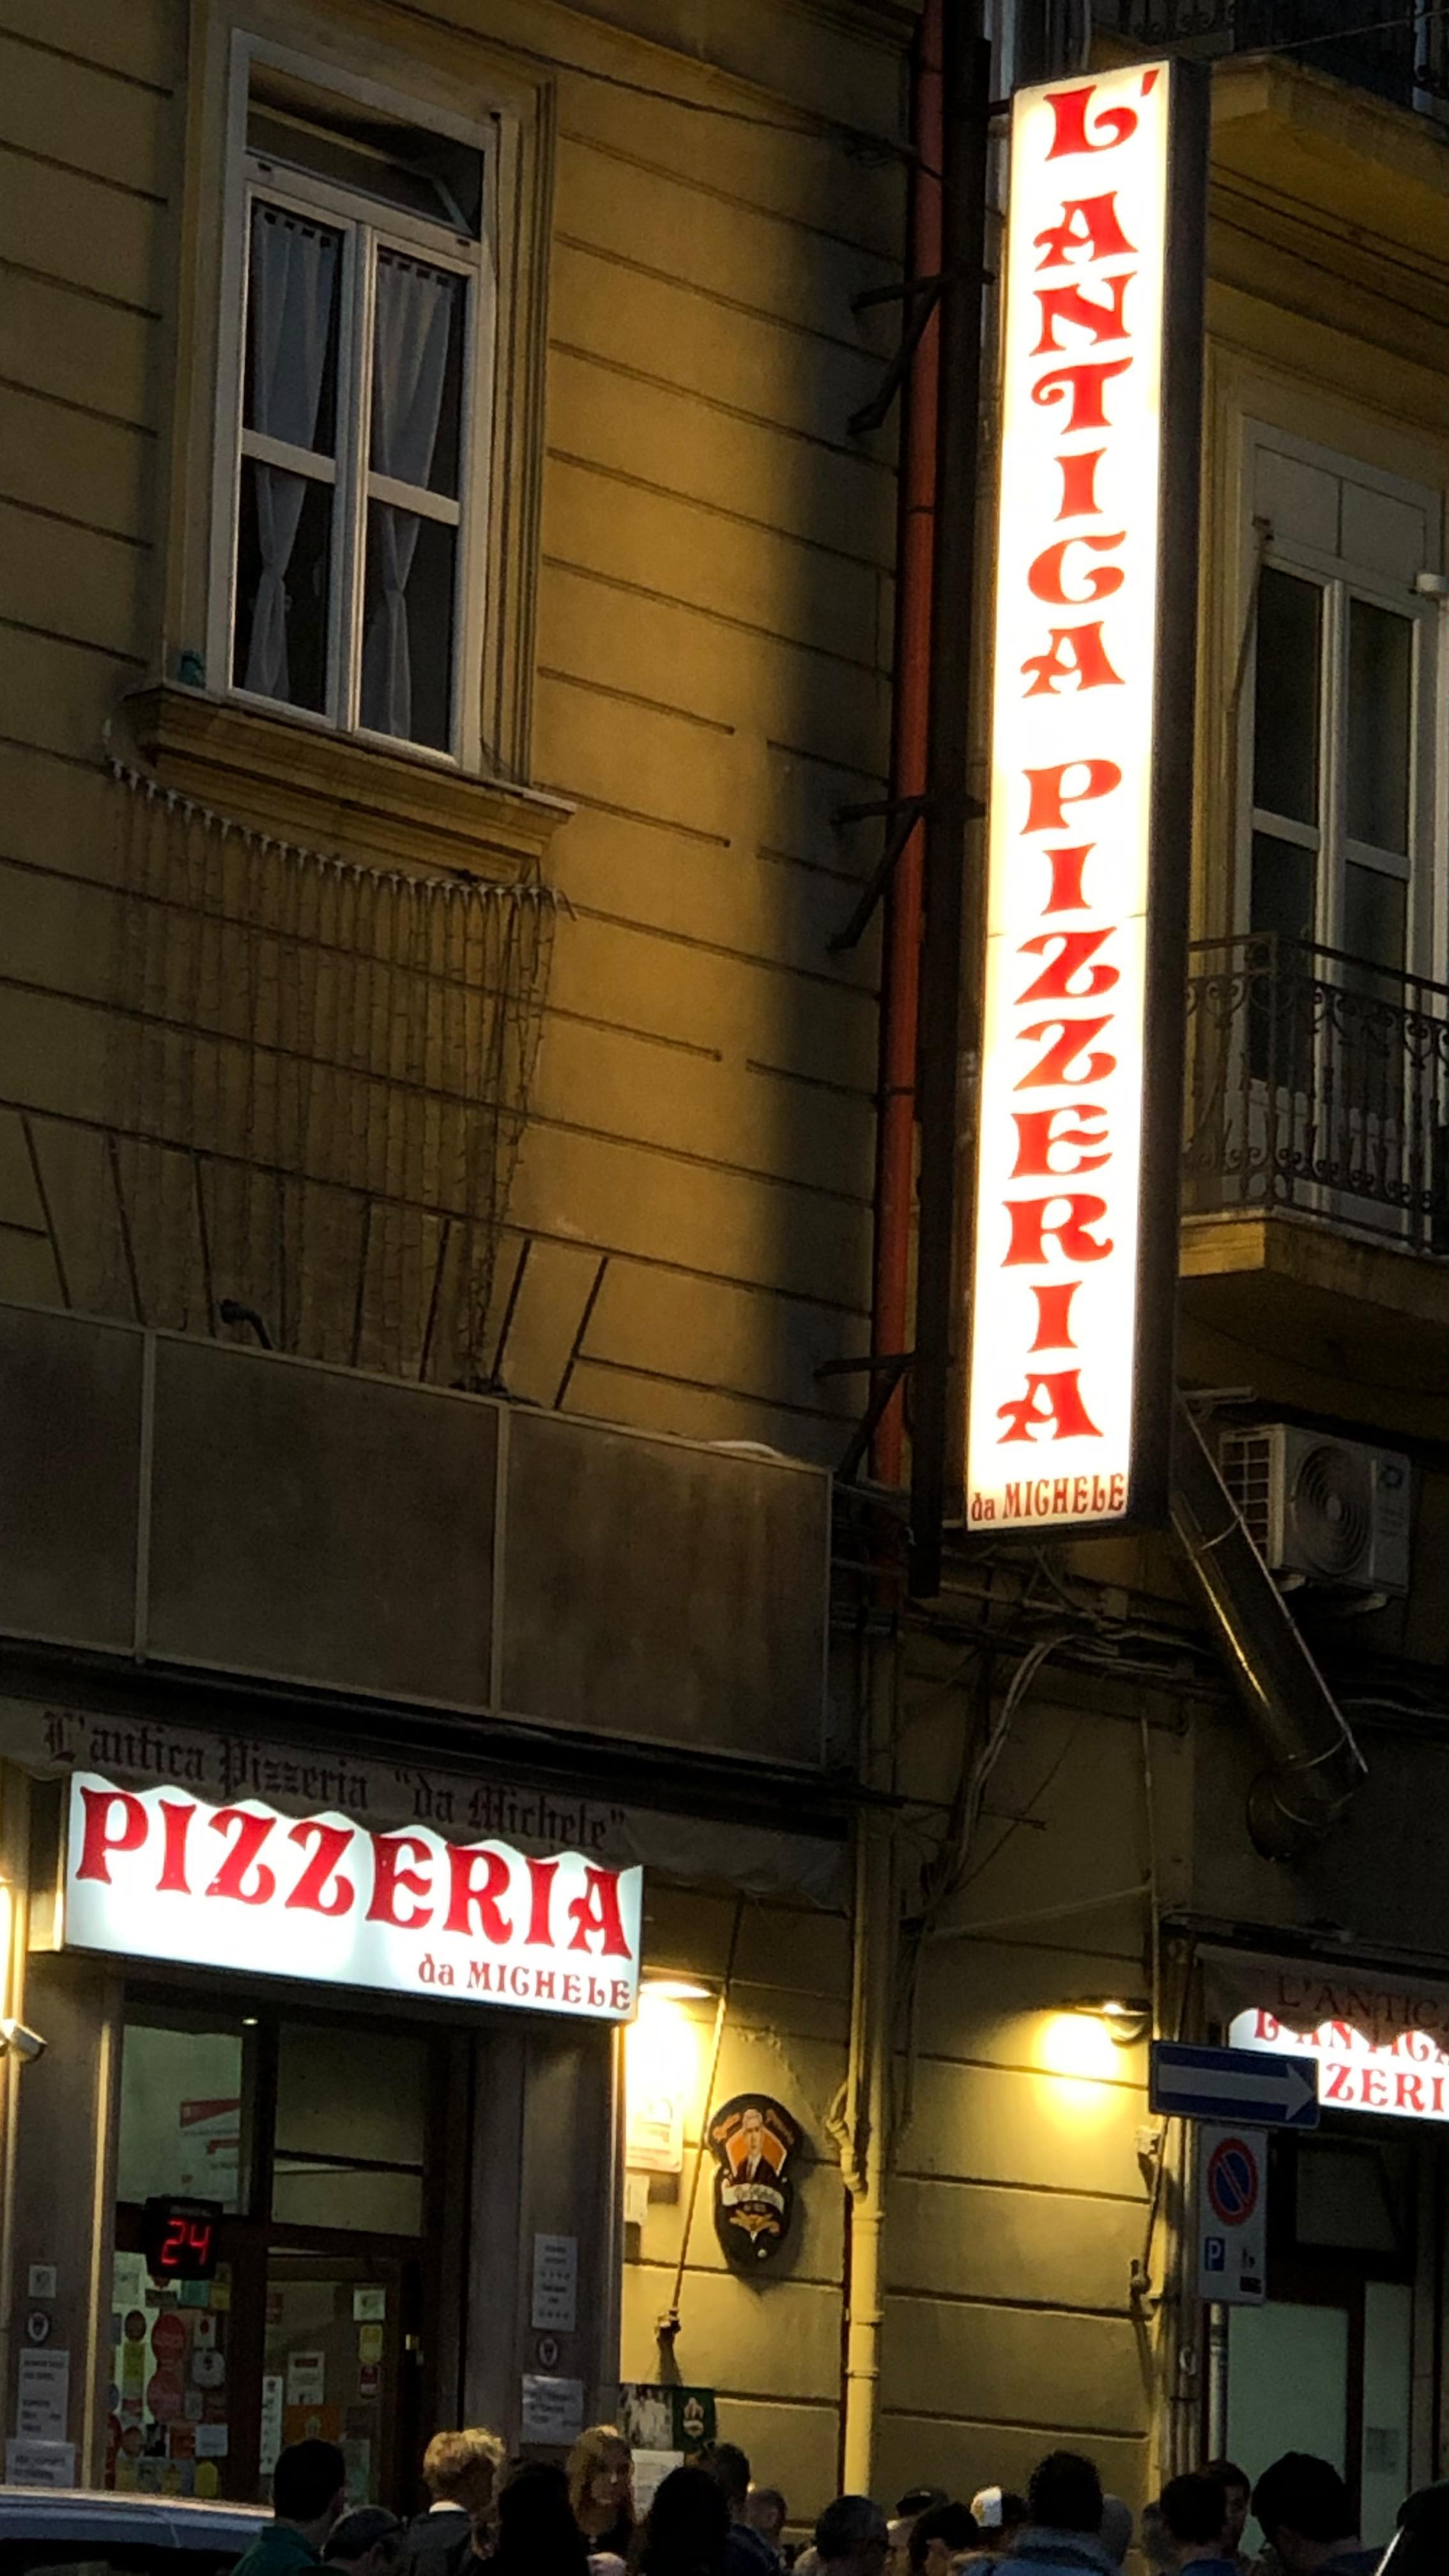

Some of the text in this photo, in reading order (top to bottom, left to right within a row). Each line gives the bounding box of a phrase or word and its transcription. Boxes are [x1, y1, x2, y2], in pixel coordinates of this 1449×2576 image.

[997, 758, 1123, 1443] PIZZERIA
[970, 1473, 1124, 1521] da MICHELE
[43, 1711, 205, 1782] L'antica
[219, 1734, 368, 1811] Pizzeria
[76, 1786, 632, 1959] PIZZERIA
[418, 1953, 631, 2011] da MICHELE
[1276, 1972, 1449, 2033] L'ANTIC
[161, 2220, 213, 2267] 24
[1207, 2239, 1223, 2271] P
